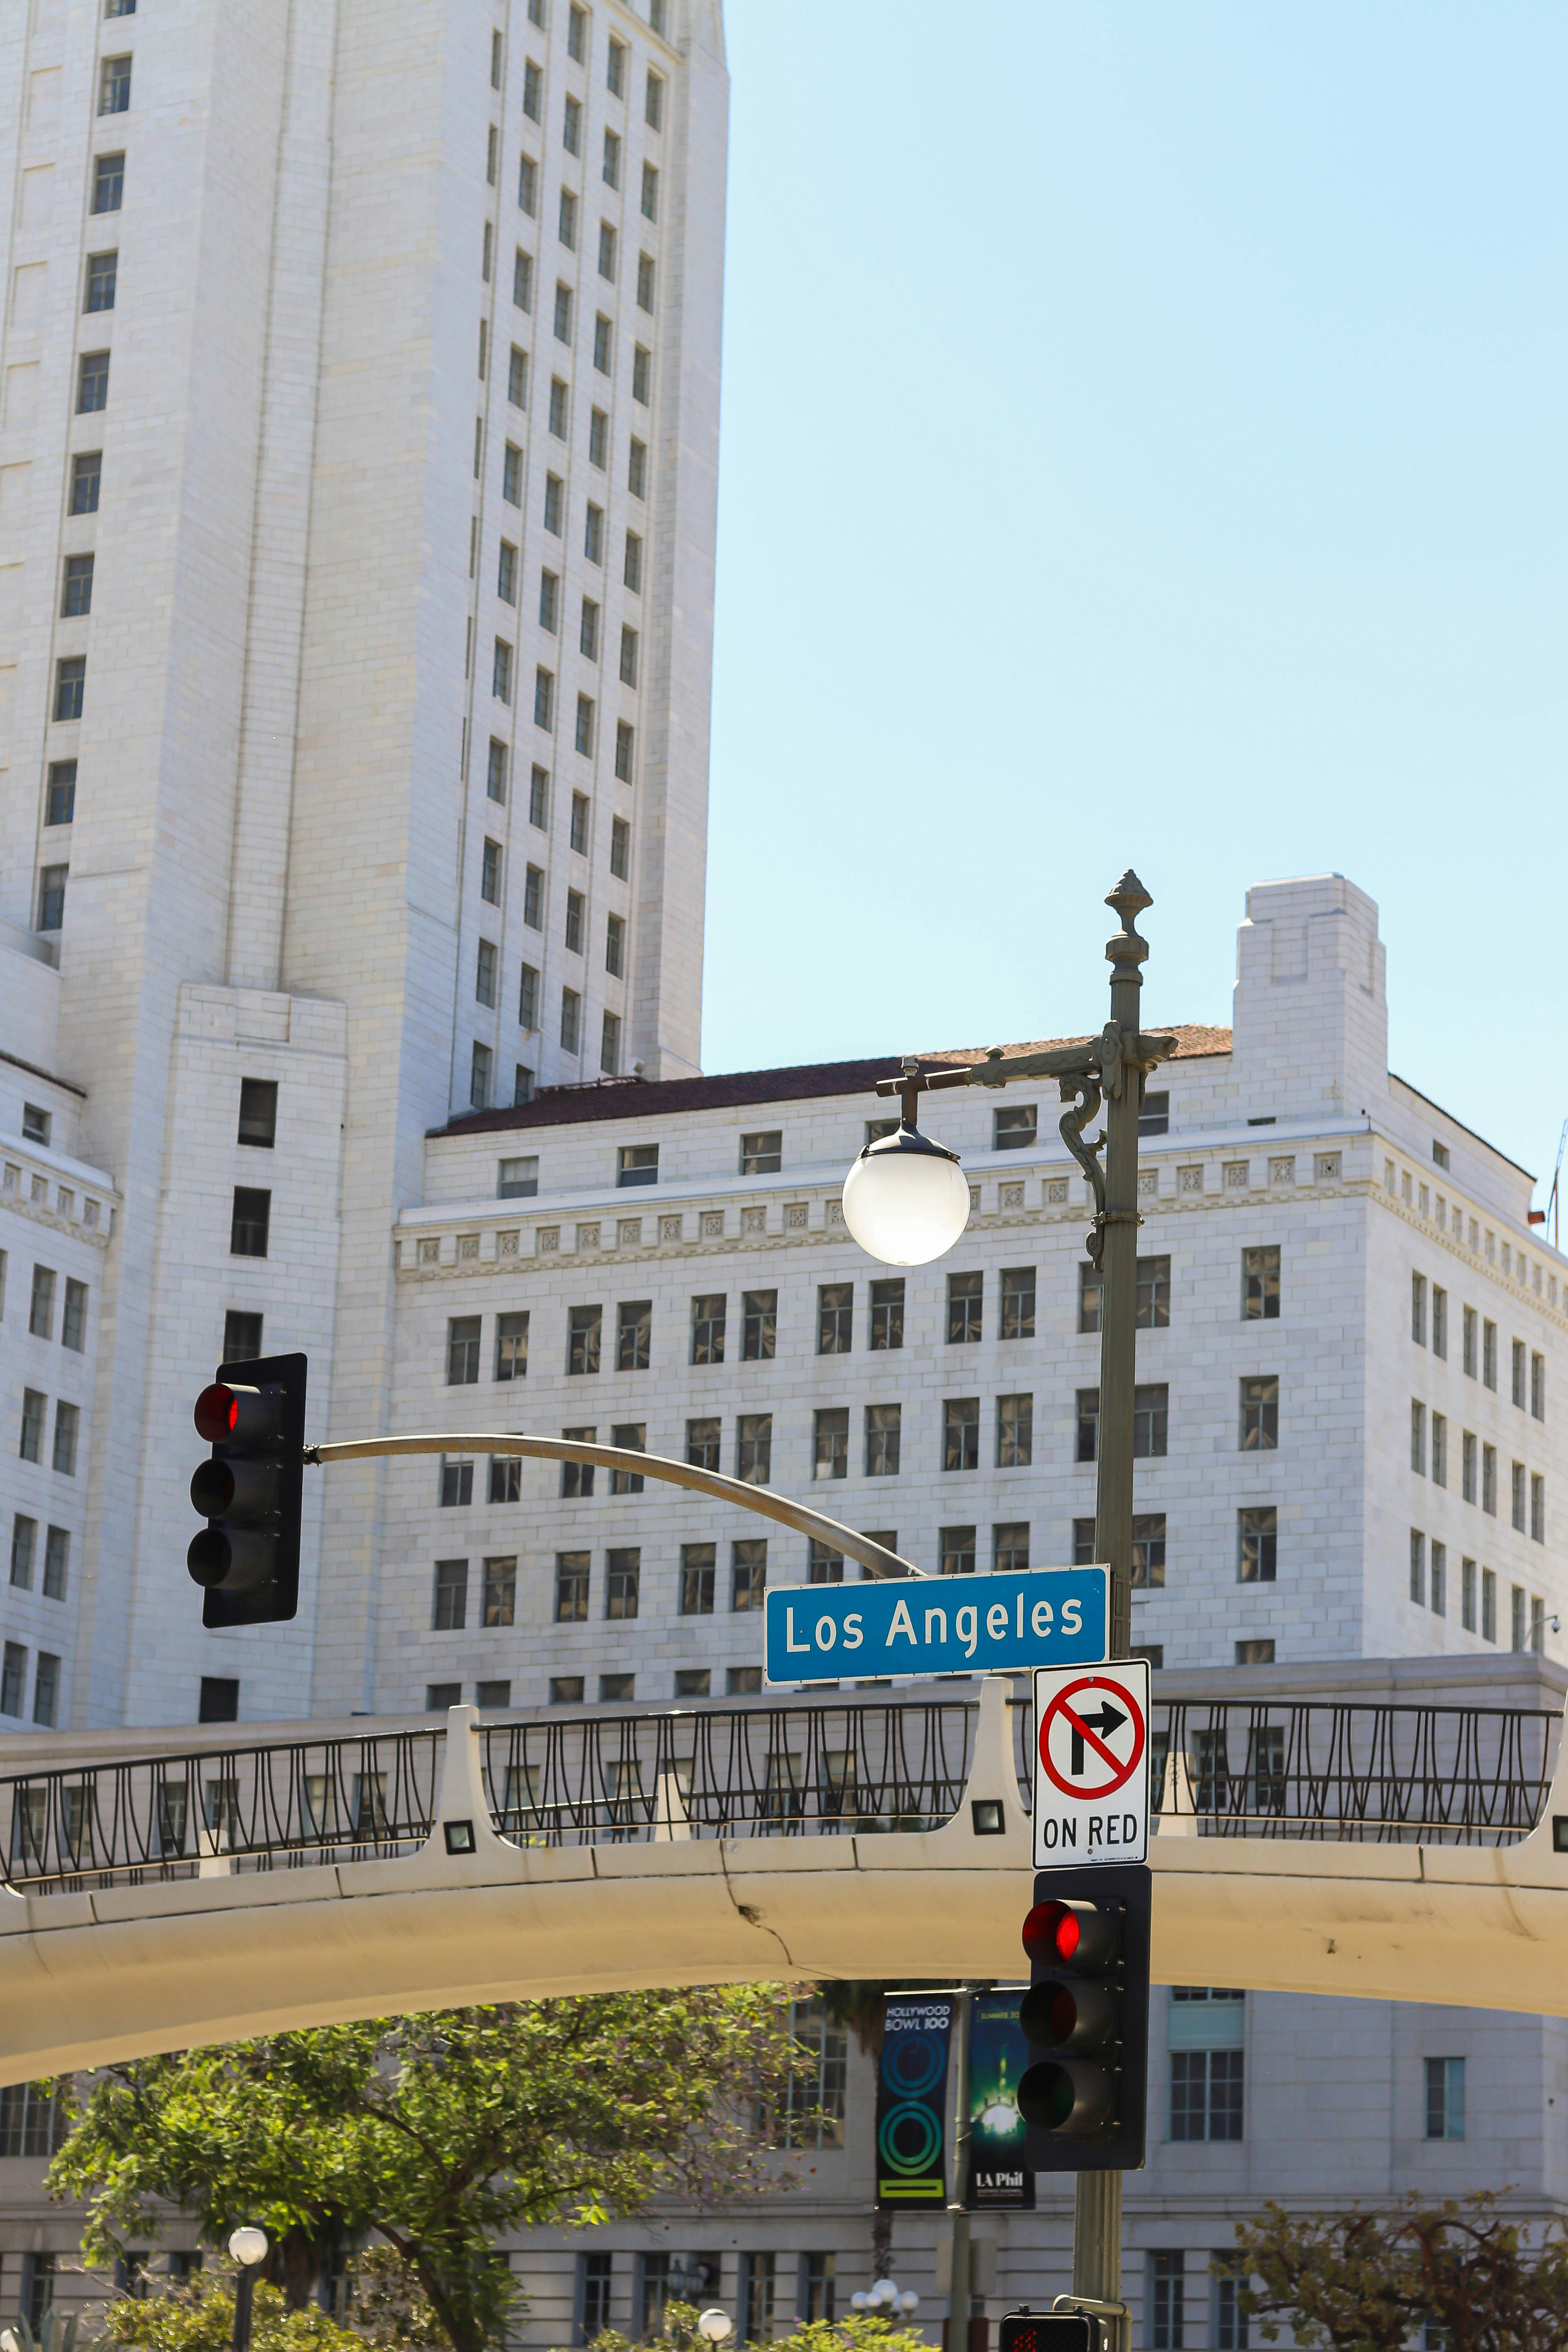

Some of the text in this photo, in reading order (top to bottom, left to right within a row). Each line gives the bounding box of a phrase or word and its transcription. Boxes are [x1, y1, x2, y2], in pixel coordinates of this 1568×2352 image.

[786, 1592, 1082, 1659] Los Angeles
[1044, 1814, 1137, 1849] ON RED
[887, 2005, 950, 2017] HOLLYWOOD
[884, 2017, 949, 2031] BOWL 100
[976, 2171, 1023, 2187] LA Phil
